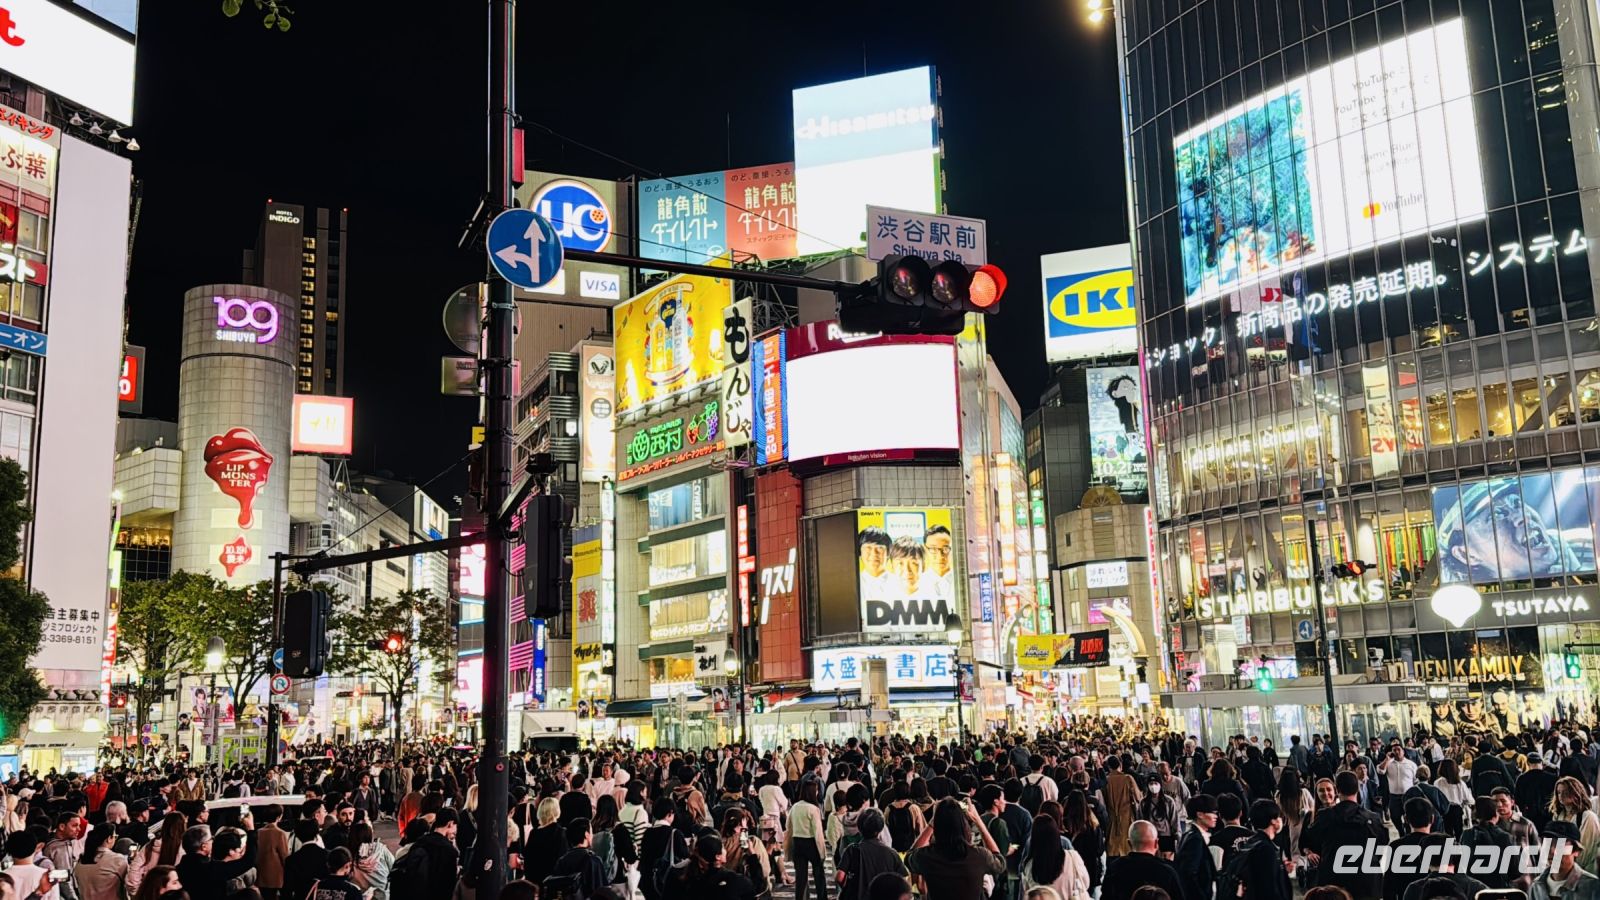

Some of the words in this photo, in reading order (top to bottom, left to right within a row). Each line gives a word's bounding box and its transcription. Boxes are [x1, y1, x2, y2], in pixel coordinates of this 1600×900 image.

[644, 176, 720, 193] のど、直接、うるおう
[744, 181, 797, 209] 龍角散
[268, 213, 301, 225] INDIGO
[656, 193, 709, 221] 龍角散
[651, 216, 719, 245] ダイレクト
[876, 214, 977, 250] 渋谷駅前
[892, 243, 940, 262] Shibuya
[942, 249, 966, 265] Sta.
[1465, 228, 1588, 277] システム
[585, 279, 618, 293] VISA
[212, 296, 279, 345] 109
[215, 329, 257, 344] SHIBUYA
[723, 305, 753, 439] もんじゃ
[650, 426, 684, 458] 西村
[225, 463, 246, 472] LIP
[847, 454, 870, 463] Rakuten
[870, 452, 888, 461] Vision
[220, 470, 257, 481] MONS
[229, 479, 252, 488] TER
[1199, 578, 1385, 619] STARBUCKS
[1491, 595, 1590, 617] TSUTAYA
[866, 599, 950, 627] DMM
[821, 653, 948, 680] 大盛書店
[1454, 655, 1524, 678] KAMUY
